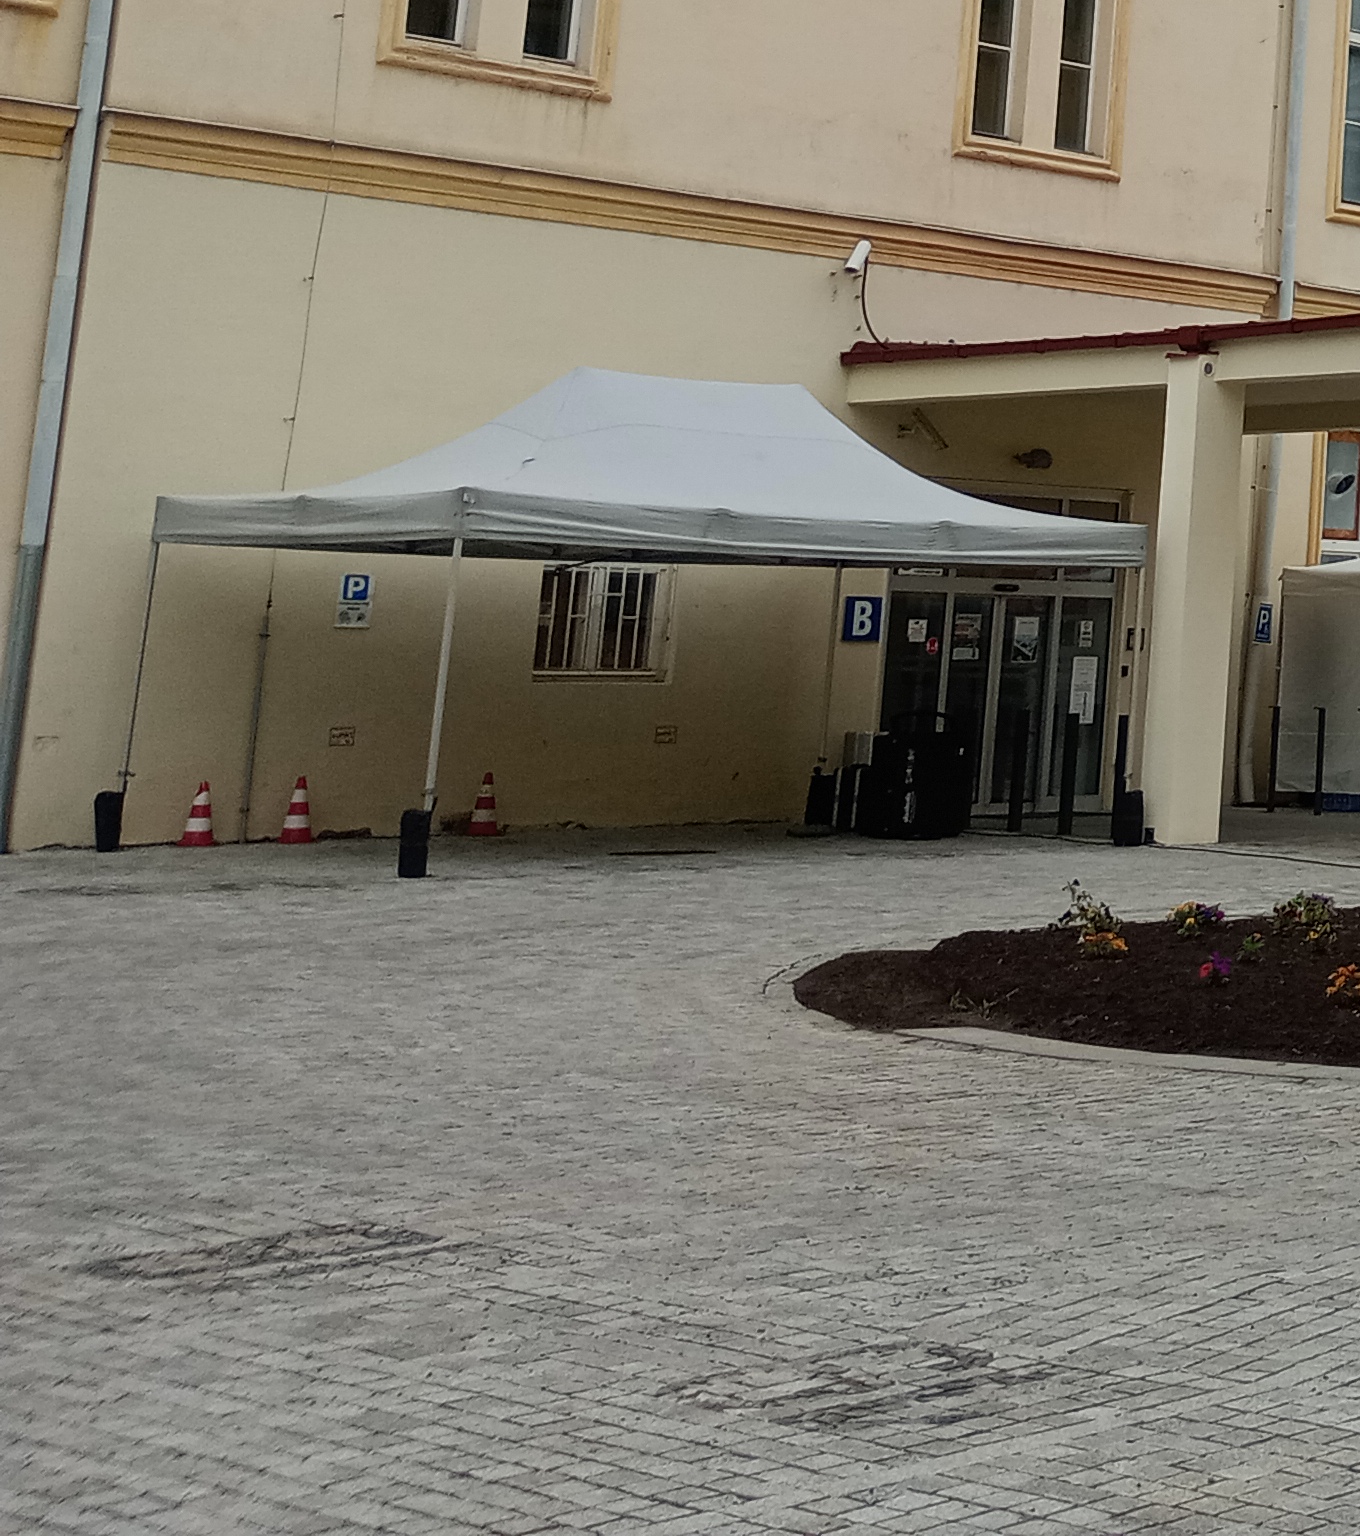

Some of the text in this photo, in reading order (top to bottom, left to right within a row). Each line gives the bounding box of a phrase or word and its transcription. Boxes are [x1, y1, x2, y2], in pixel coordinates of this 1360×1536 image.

[347, 576, 366, 599] P
[852, 600, 873, 636] B
[1258, 610, 1270, 631] P
